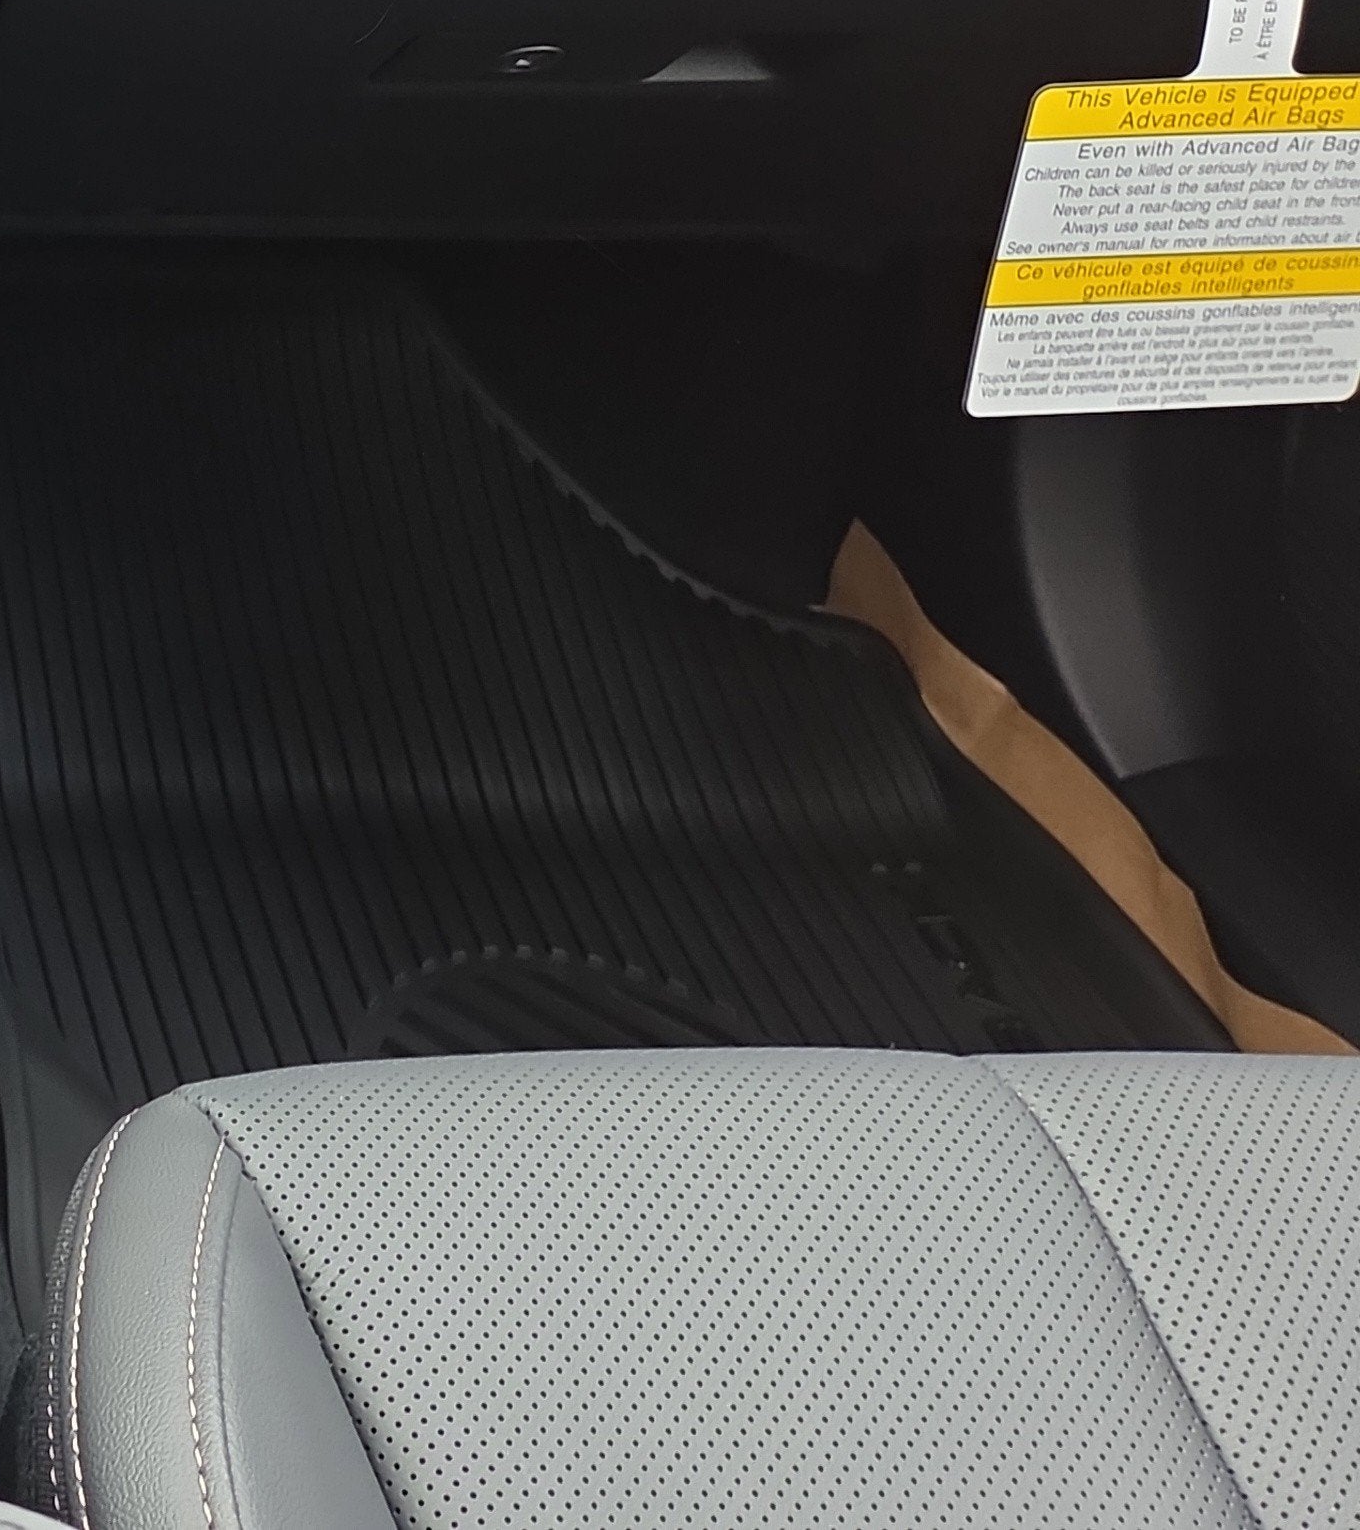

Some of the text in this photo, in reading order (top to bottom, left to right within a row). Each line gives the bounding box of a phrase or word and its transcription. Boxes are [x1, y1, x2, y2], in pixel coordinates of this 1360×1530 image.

[1233, 7, 1247, 23] BE
[1229, 27, 1244, 43] TO
[1067, 81, 1358, 108] This Vehicle is Equipped
[1118, 104, 1345, 130] Advanced Air Bags
[1077, 143, 1126, 160] Even
[1135, 140, 1174, 157] with
[1182, 137, 1280, 156] Advanced
[1287, 136, 1315, 153] Air
[1024, 159, 1356, 182] Children can be killed or seriously injured by the
[1059, 184, 1083, 199] The
[1088, 182, 1122, 198] back
[1125, 182, 1156, 196] seat
[1160, 181, 1172, 195] is
[1177, 180, 1199, 194] the
[1204, 179, 1246, 194] safest
[1248, 178, 1286, 195] place
[1291, 177, 1311, 191] for
[1053, 202, 1094, 217] Never
[1097, 203, 1120, 217] put
[1124, 204, 1133, 214] a
[1139, 199, 1211, 215] rear-facing
[1216, 197, 1248, 211] child
[1252, 196, 1282, 210] seat
[1286, 196, 1299, 208] in
[1304, 195, 1326, 208] the
[1061, 221, 1109, 237] Always
[1114, 221, 1138, 233] use
[1144, 218, 1173, 232] seat
[1177, 217, 1210, 231] belts
[1214, 216, 1241, 229] and
[1245, 215, 1278, 228] child
[1006, 240, 1033, 255] See
[1037, 239, 1090, 254] owner's
[1095, 237, 1146, 251] manual
[1150, 236, 1169, 250] for
[1173, 235, 1207, 248] more
[1212, 233, 1286, 248] information
[1291, 231, 1329, 245] about
[1333, 231, 1352, 244] air
[1016, 264, 1044, 280] Ce
[1053, 260, 1133, 279] véhicule
[1141, 259, 1172, 276] est
[1180, 255, 1245, 276] équipé
[1253, 255, 1278, 272] de
[1082, 274, 1295, 302] gonflables intelligents
[989, 312, 1039, 327] Même
[1045, 311, 1085, 325] avec
[1091, 308, 1120, 324] des
[1126, 306, 1196, 322] coussins
[1201, 302, 1283, 323] gonflables
